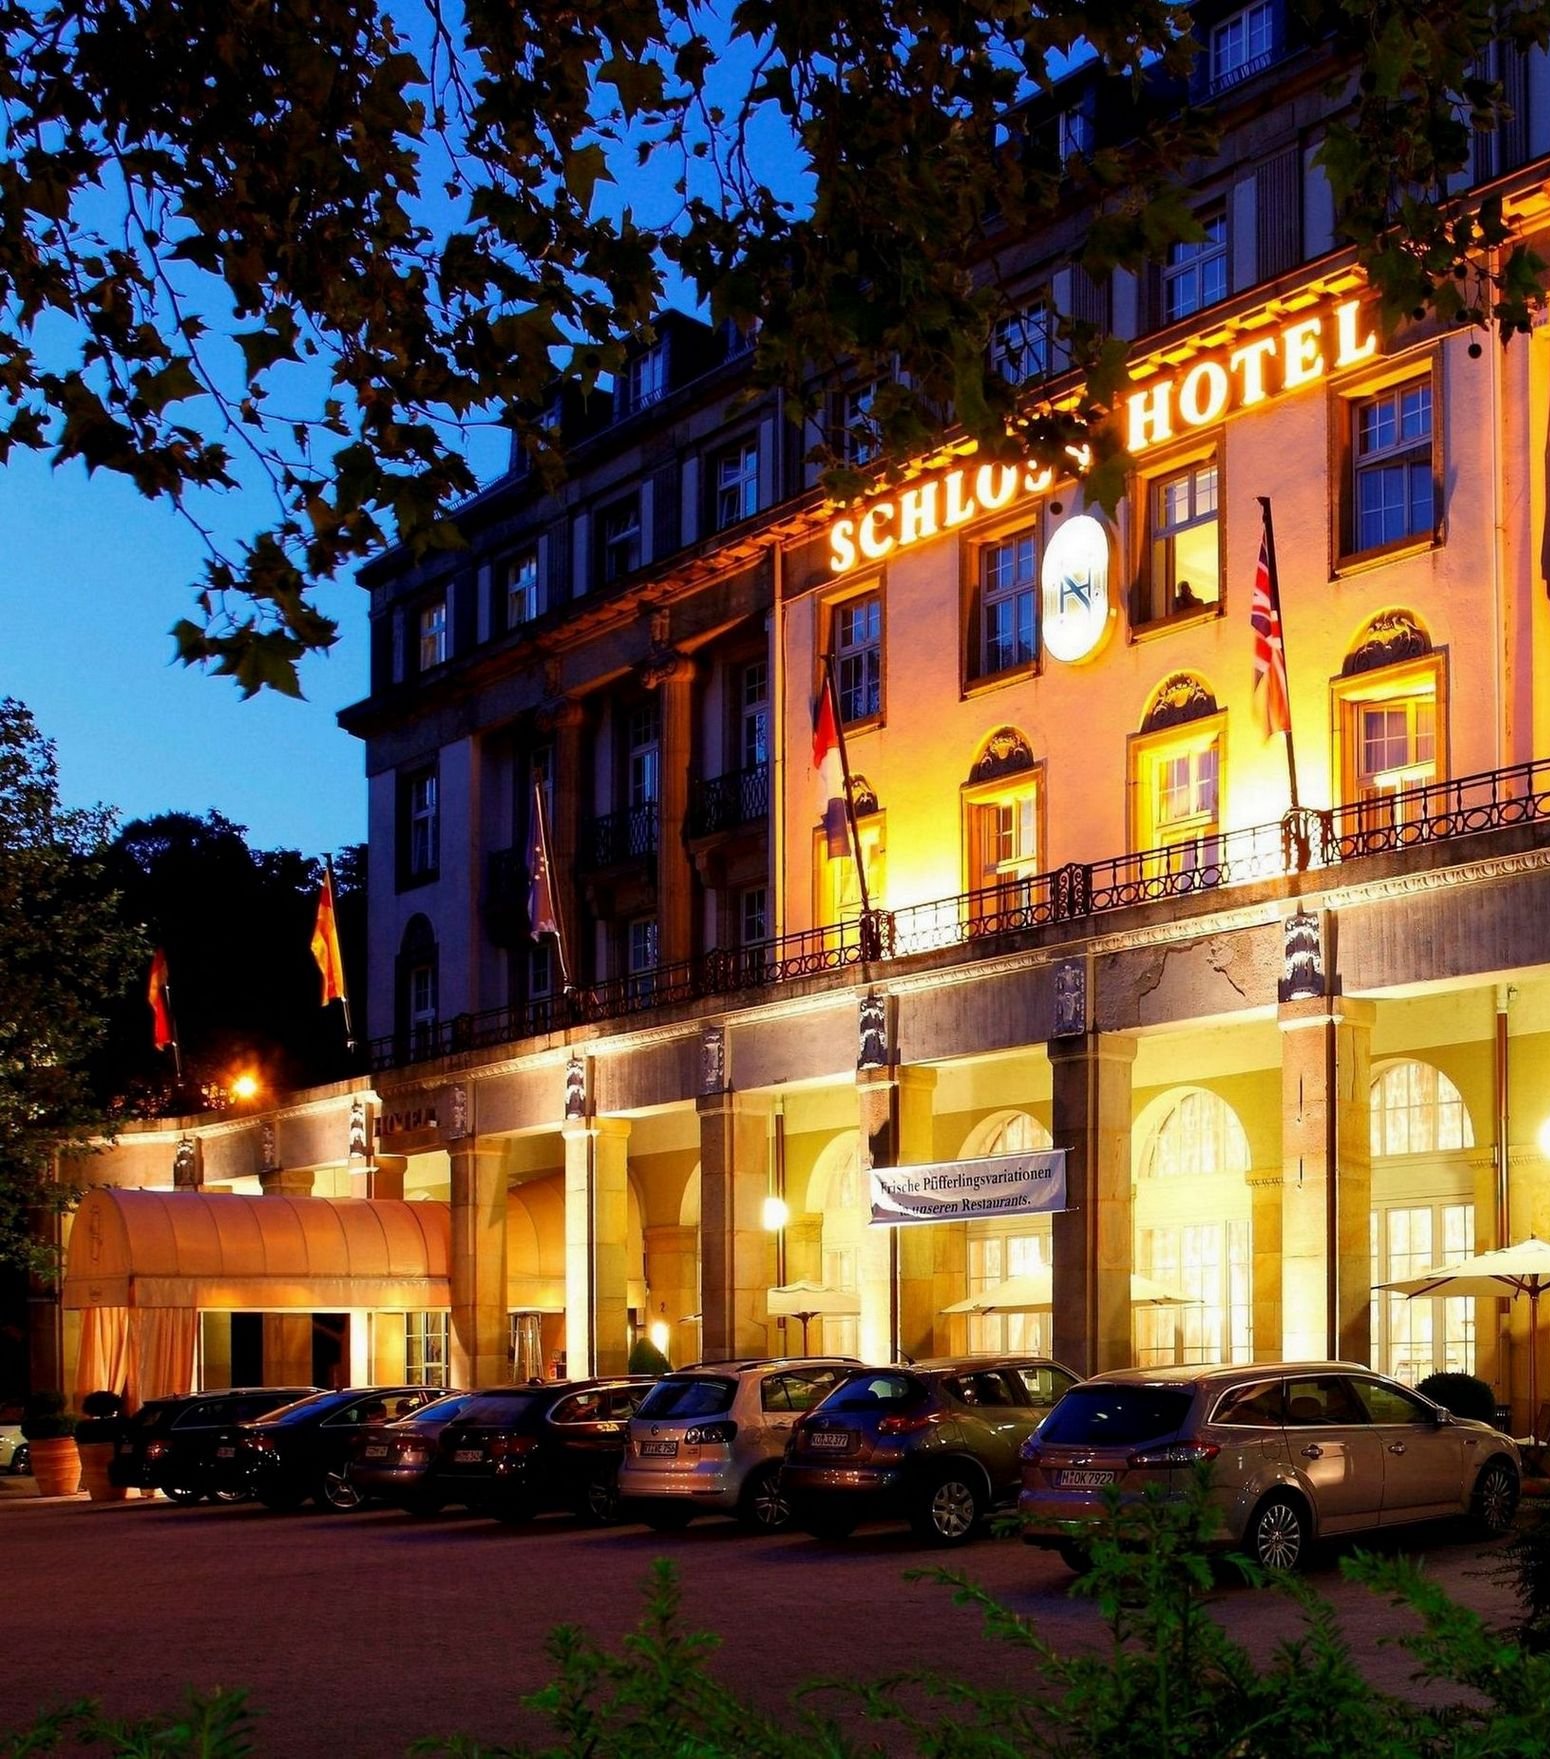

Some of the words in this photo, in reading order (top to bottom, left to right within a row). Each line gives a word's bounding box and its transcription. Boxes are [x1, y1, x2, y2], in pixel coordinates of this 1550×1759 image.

[1127, 300, 1378, 452] HOTEL
[881, 1180, 920, 1195] Frische
[923, 1168, 1052, 1191] Pfifferlingsvariationen
[912, 1203, 958, 1215] unseren
[962, 1195, 1031, 1212] Restaurants.
